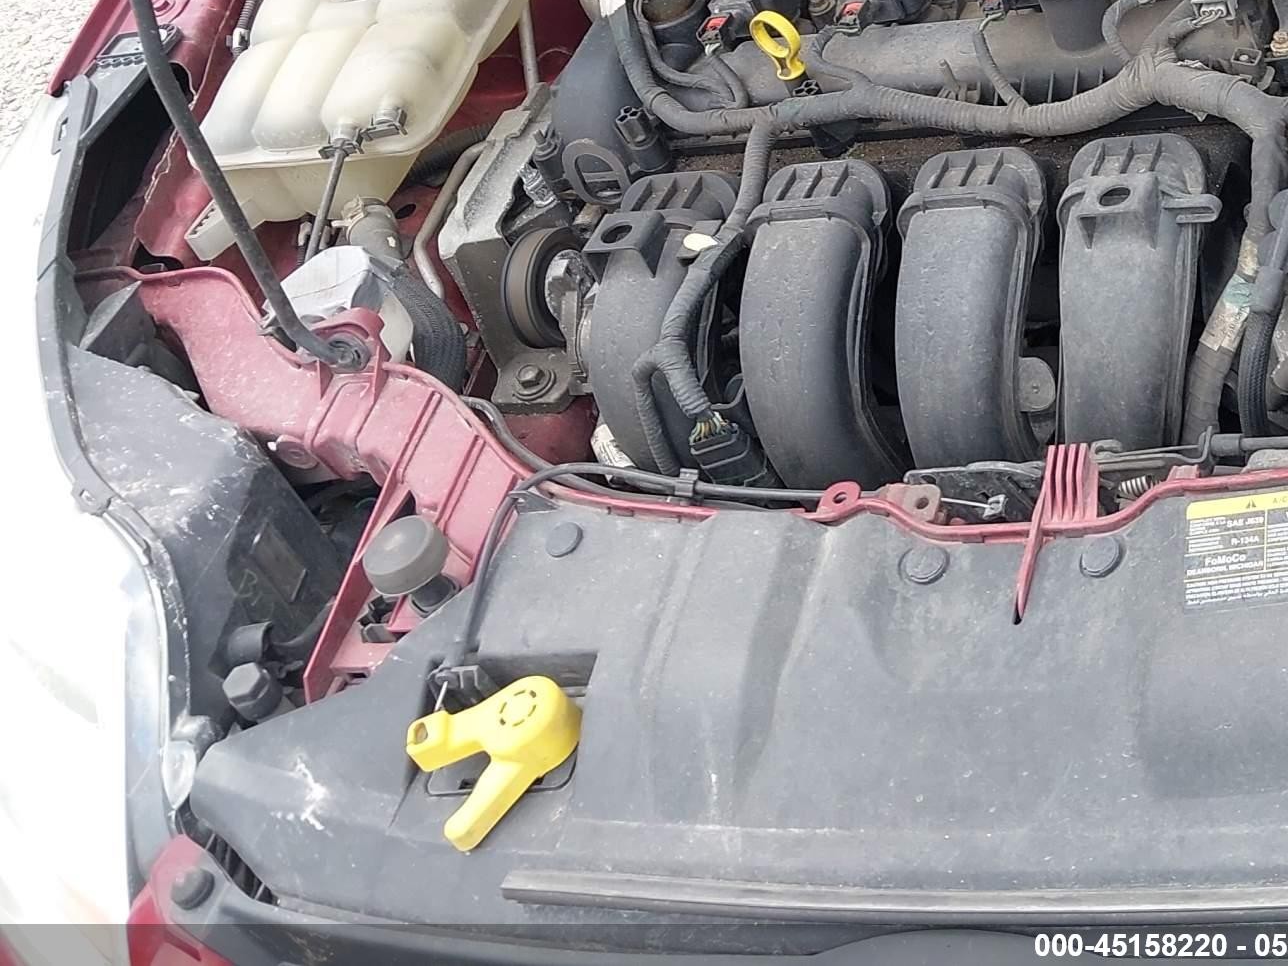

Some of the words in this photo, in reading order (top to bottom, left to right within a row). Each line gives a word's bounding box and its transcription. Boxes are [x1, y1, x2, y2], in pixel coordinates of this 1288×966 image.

[1226, 518, 1244, 529] SAE
[1230, 535, 1260, 546] R-134A
[1204, 553, 1247, 566] FoMoCo
